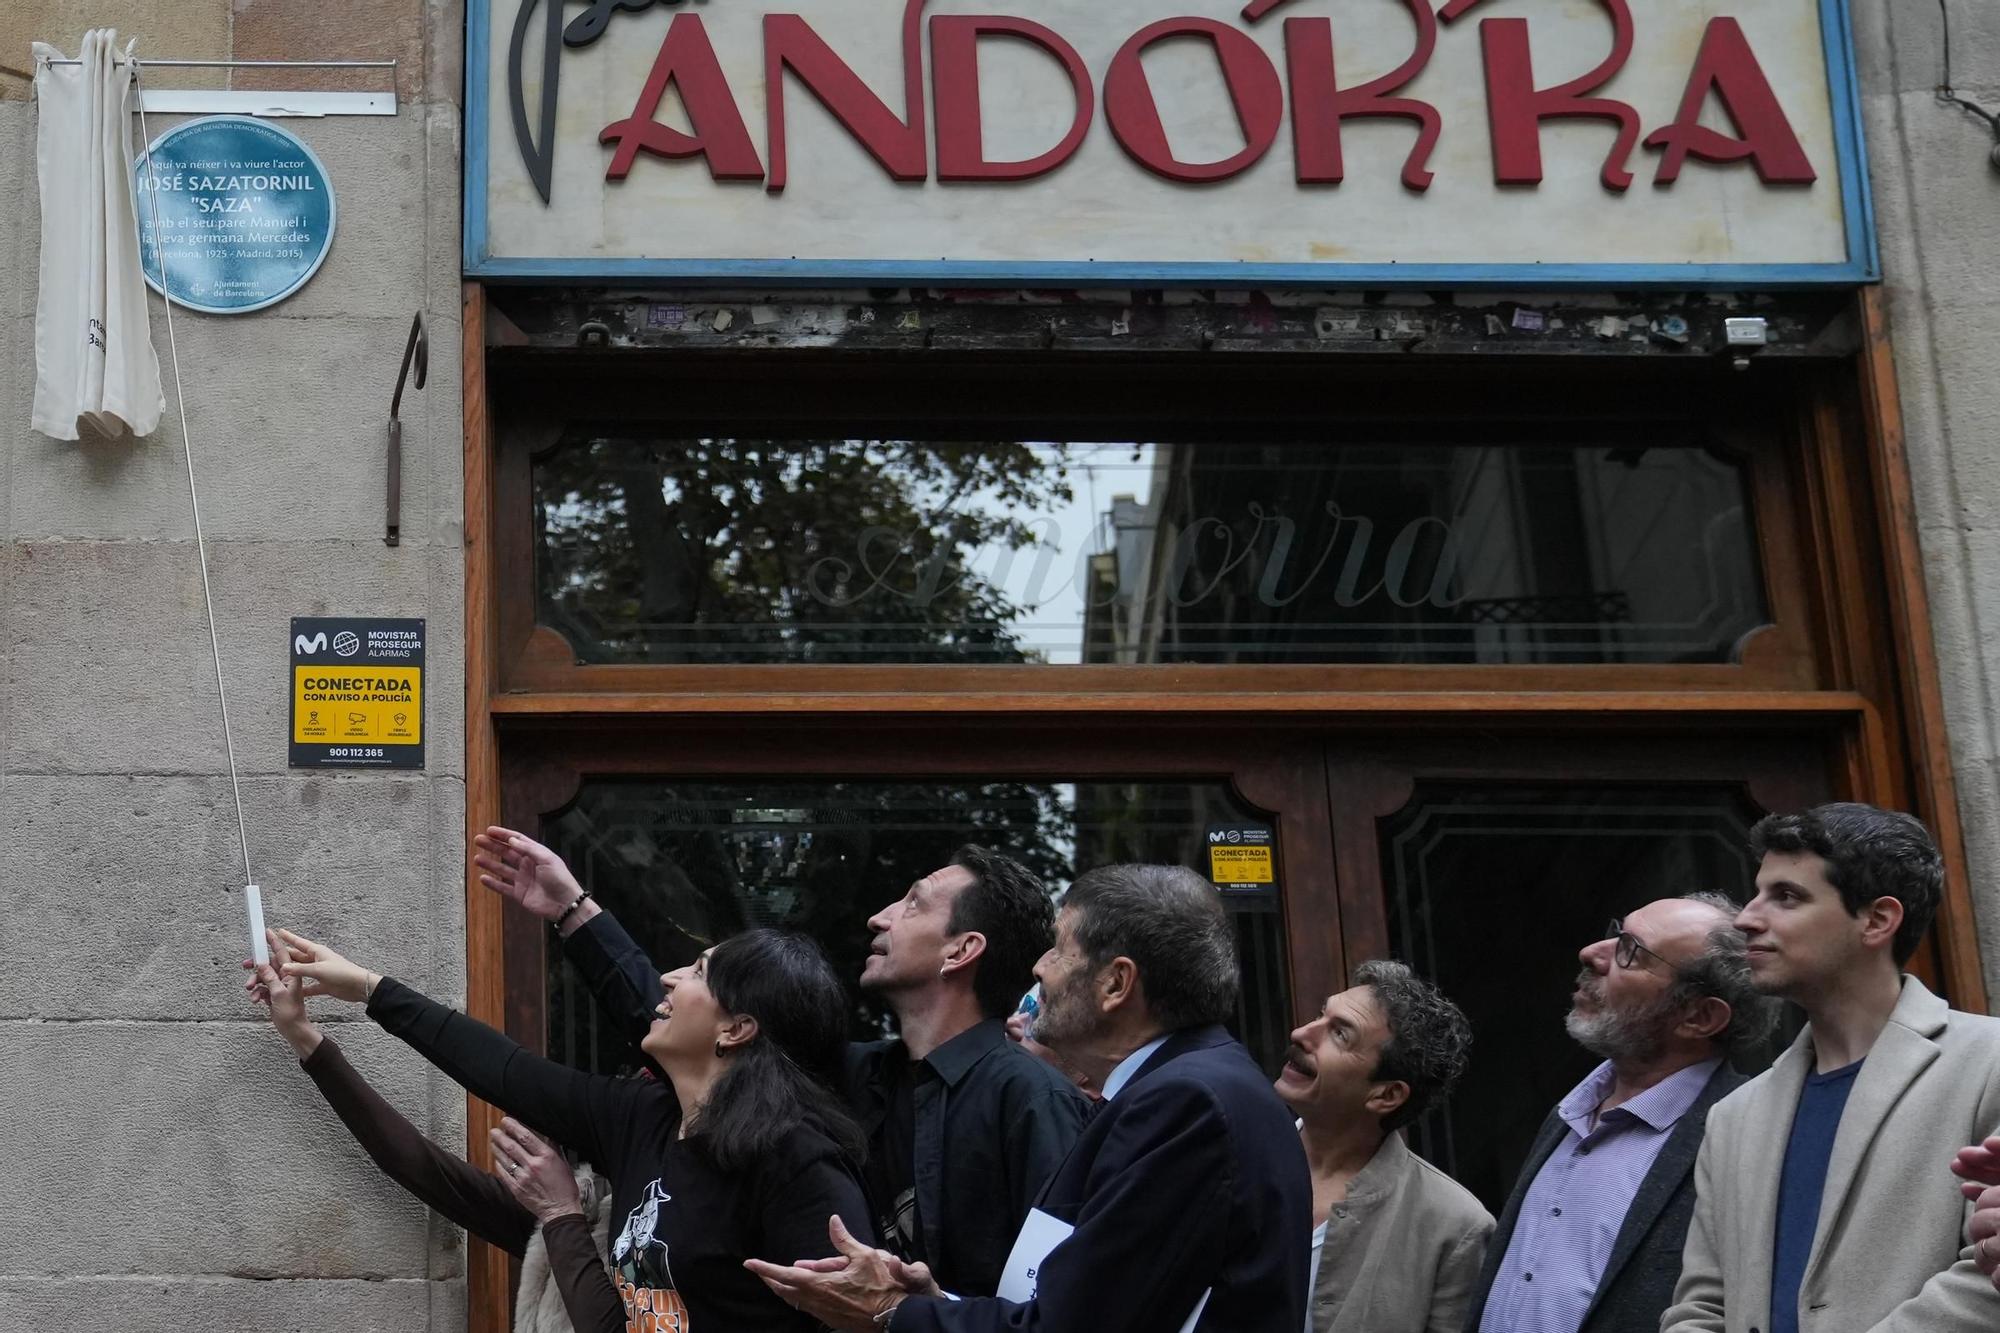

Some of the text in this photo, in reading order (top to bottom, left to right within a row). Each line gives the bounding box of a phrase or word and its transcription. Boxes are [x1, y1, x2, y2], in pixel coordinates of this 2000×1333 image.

[599, 0, 1817, 193] ANDORRA
[190, 160, 221, 169] néixer
[244, 160, 270, 169] viure
[273, 159, 305, 169] l'actor
[138, 173, 315, 194] JOSÉ SAZATORNIL
[191, 197, 261, 212] "SAZA"
[178, 217, 188, 228] el
[193, 219, 214, 228] seu
[218, 219, 246, 231] pare
[250, 216, 299, 228] Manuel
[303, 216, 307, 228] i
[142, 231, 311, 246] la eva germana Mercedes
[207, 250, 227, 258] 1925
[236, 249, 274, 259] Madrid,
[276, 249, 303, 259] 2015)
[213, 280, 259, 289] Ajuntament
[368, 631, 417, 640] MOVISTAR
[368, 640, 421, 649] PROSEGUR
[303, 678, 412, 691] CONECTADA
[303, 692, 412, 702] CON AVISO A POLICÍA
[329, 748, 384, 757] 900 112 365
